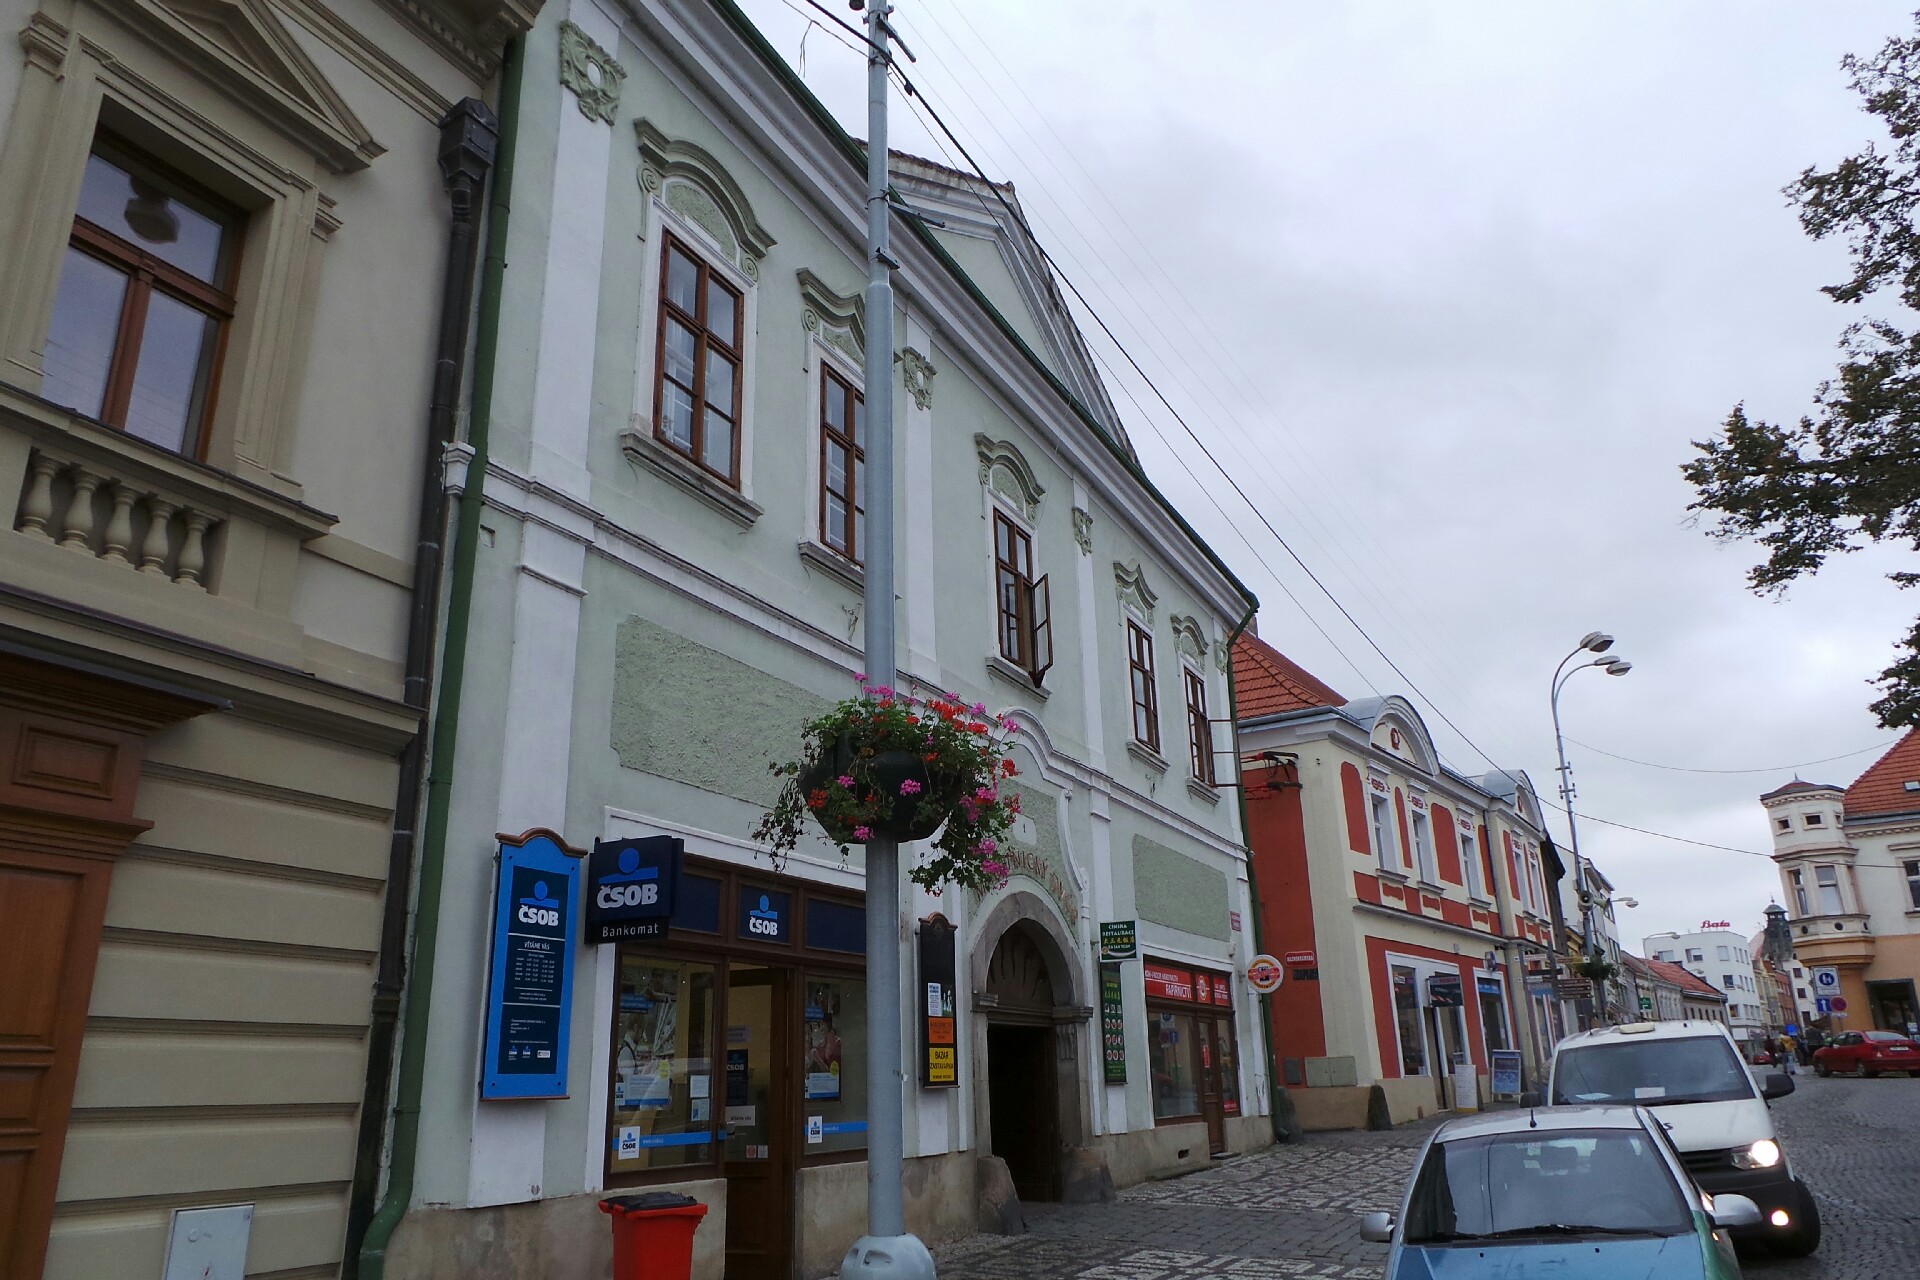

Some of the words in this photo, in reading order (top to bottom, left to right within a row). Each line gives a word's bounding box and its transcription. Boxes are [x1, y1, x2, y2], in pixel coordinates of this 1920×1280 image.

[596, 883, 659, 909] ČSOB
[518, 905, 559, 927] ČSOB
[749, 916, 778, 936] ČSOB
[602, 922, 660, 938] Bankomat
[934, 1051, 949, 1060] BAZAR
